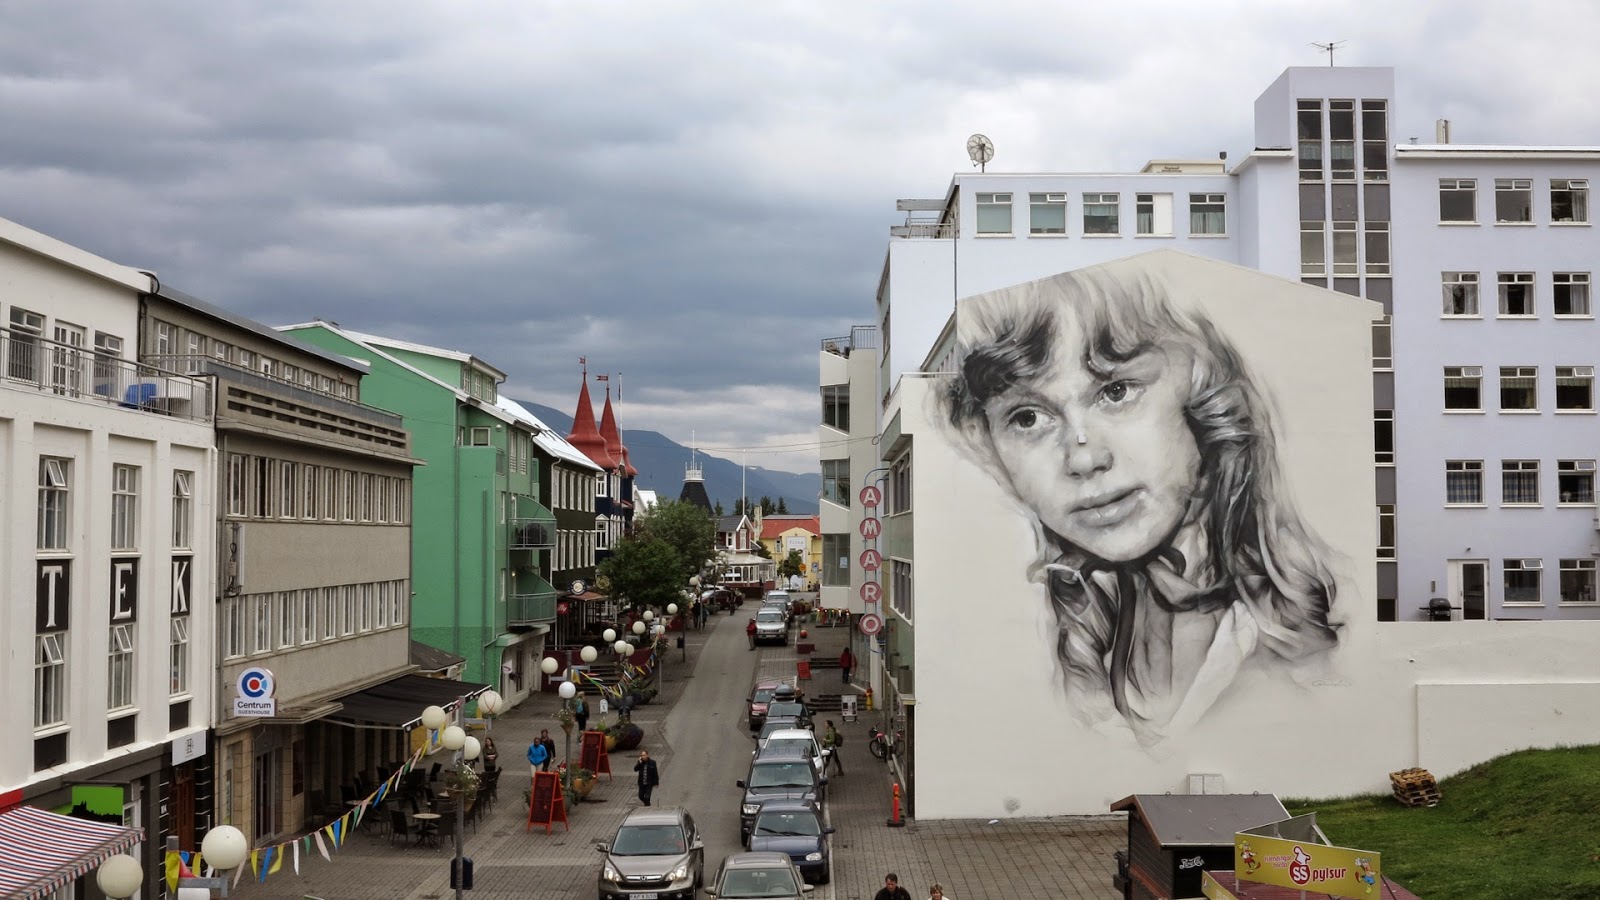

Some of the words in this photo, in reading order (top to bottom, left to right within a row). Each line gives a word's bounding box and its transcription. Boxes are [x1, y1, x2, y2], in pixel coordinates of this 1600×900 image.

[863, 488, 879, 632] AMARO
[237, 701, 271, 709] Centrum
[1293, 866, 1308, 881] SS
[1312, 867, 1347, 882] pylsur
